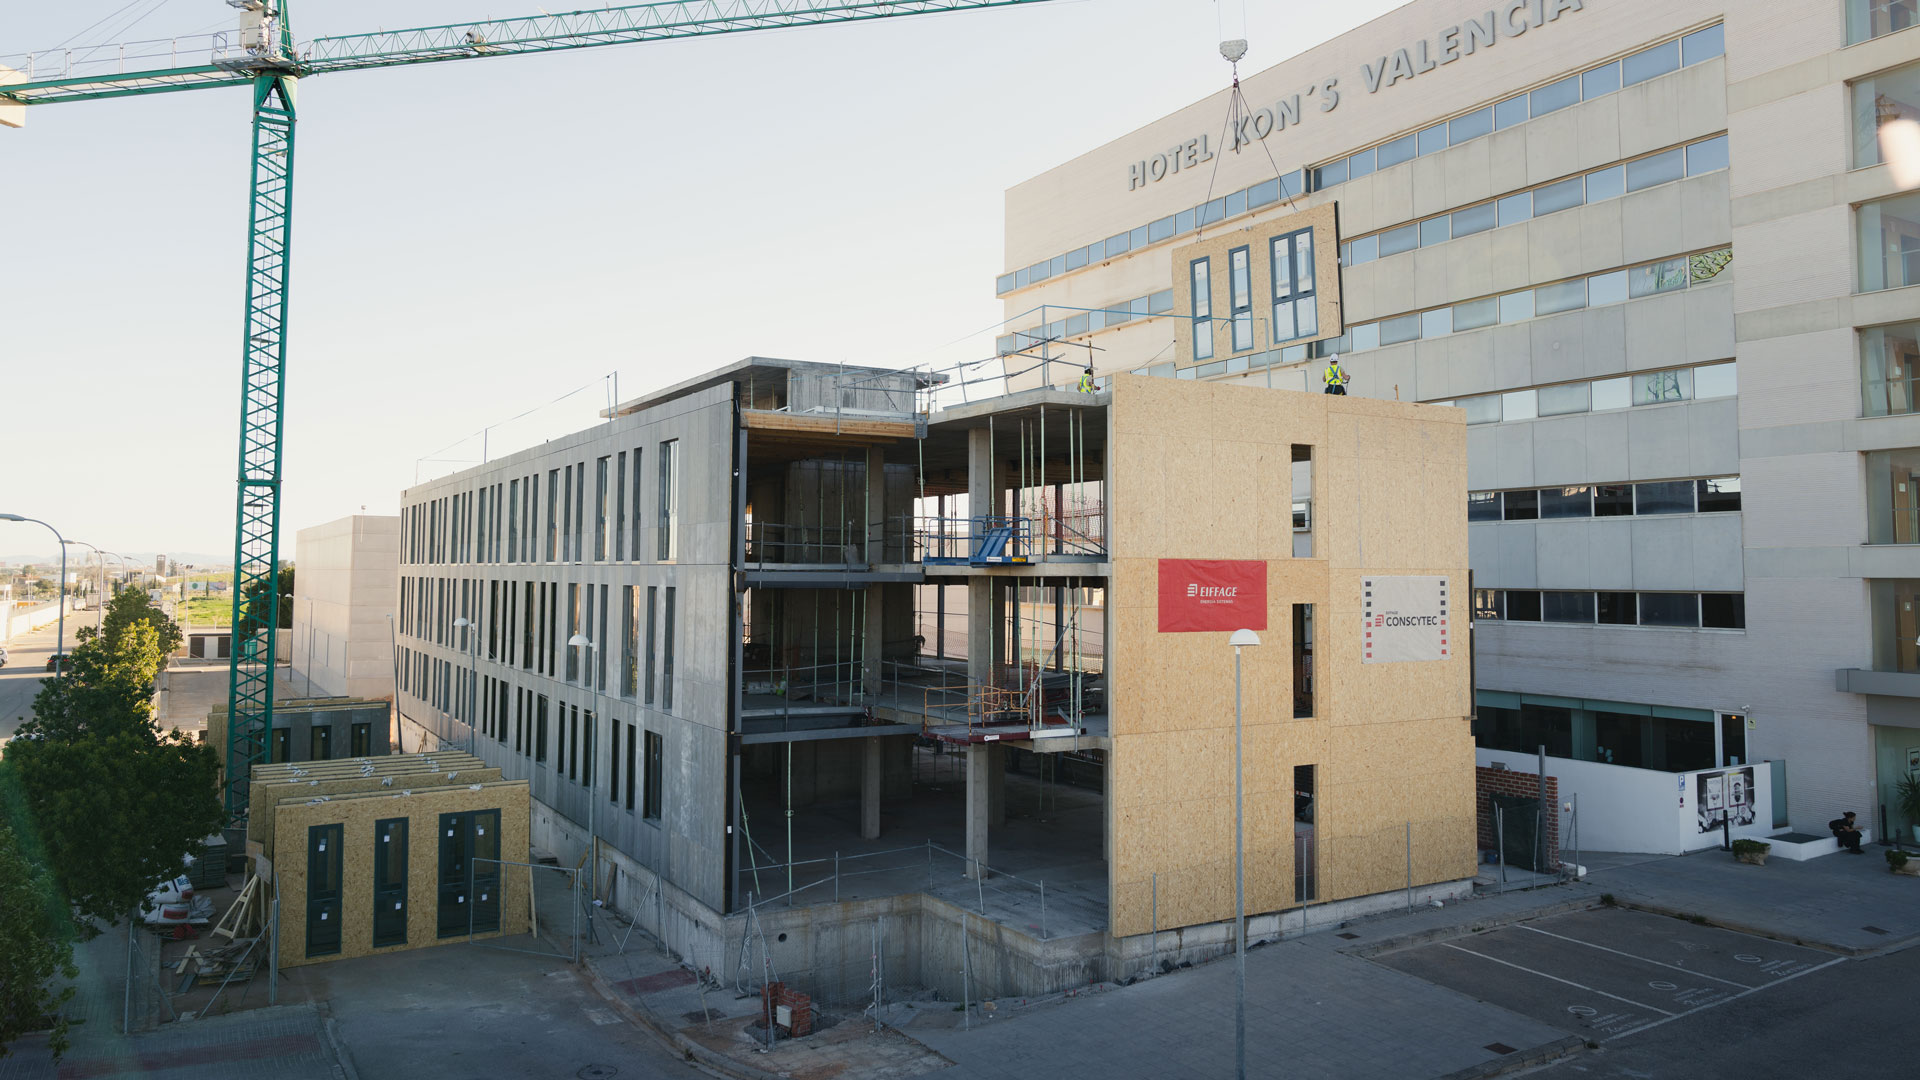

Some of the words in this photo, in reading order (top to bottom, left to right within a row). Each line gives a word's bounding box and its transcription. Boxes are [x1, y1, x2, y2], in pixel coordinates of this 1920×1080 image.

[1128, 134, 1213, 191] HOTEL
[1200, 586, 1237, 597] EIFFAGE
[1386, 616, 1437, 626] CONSCYTEC
